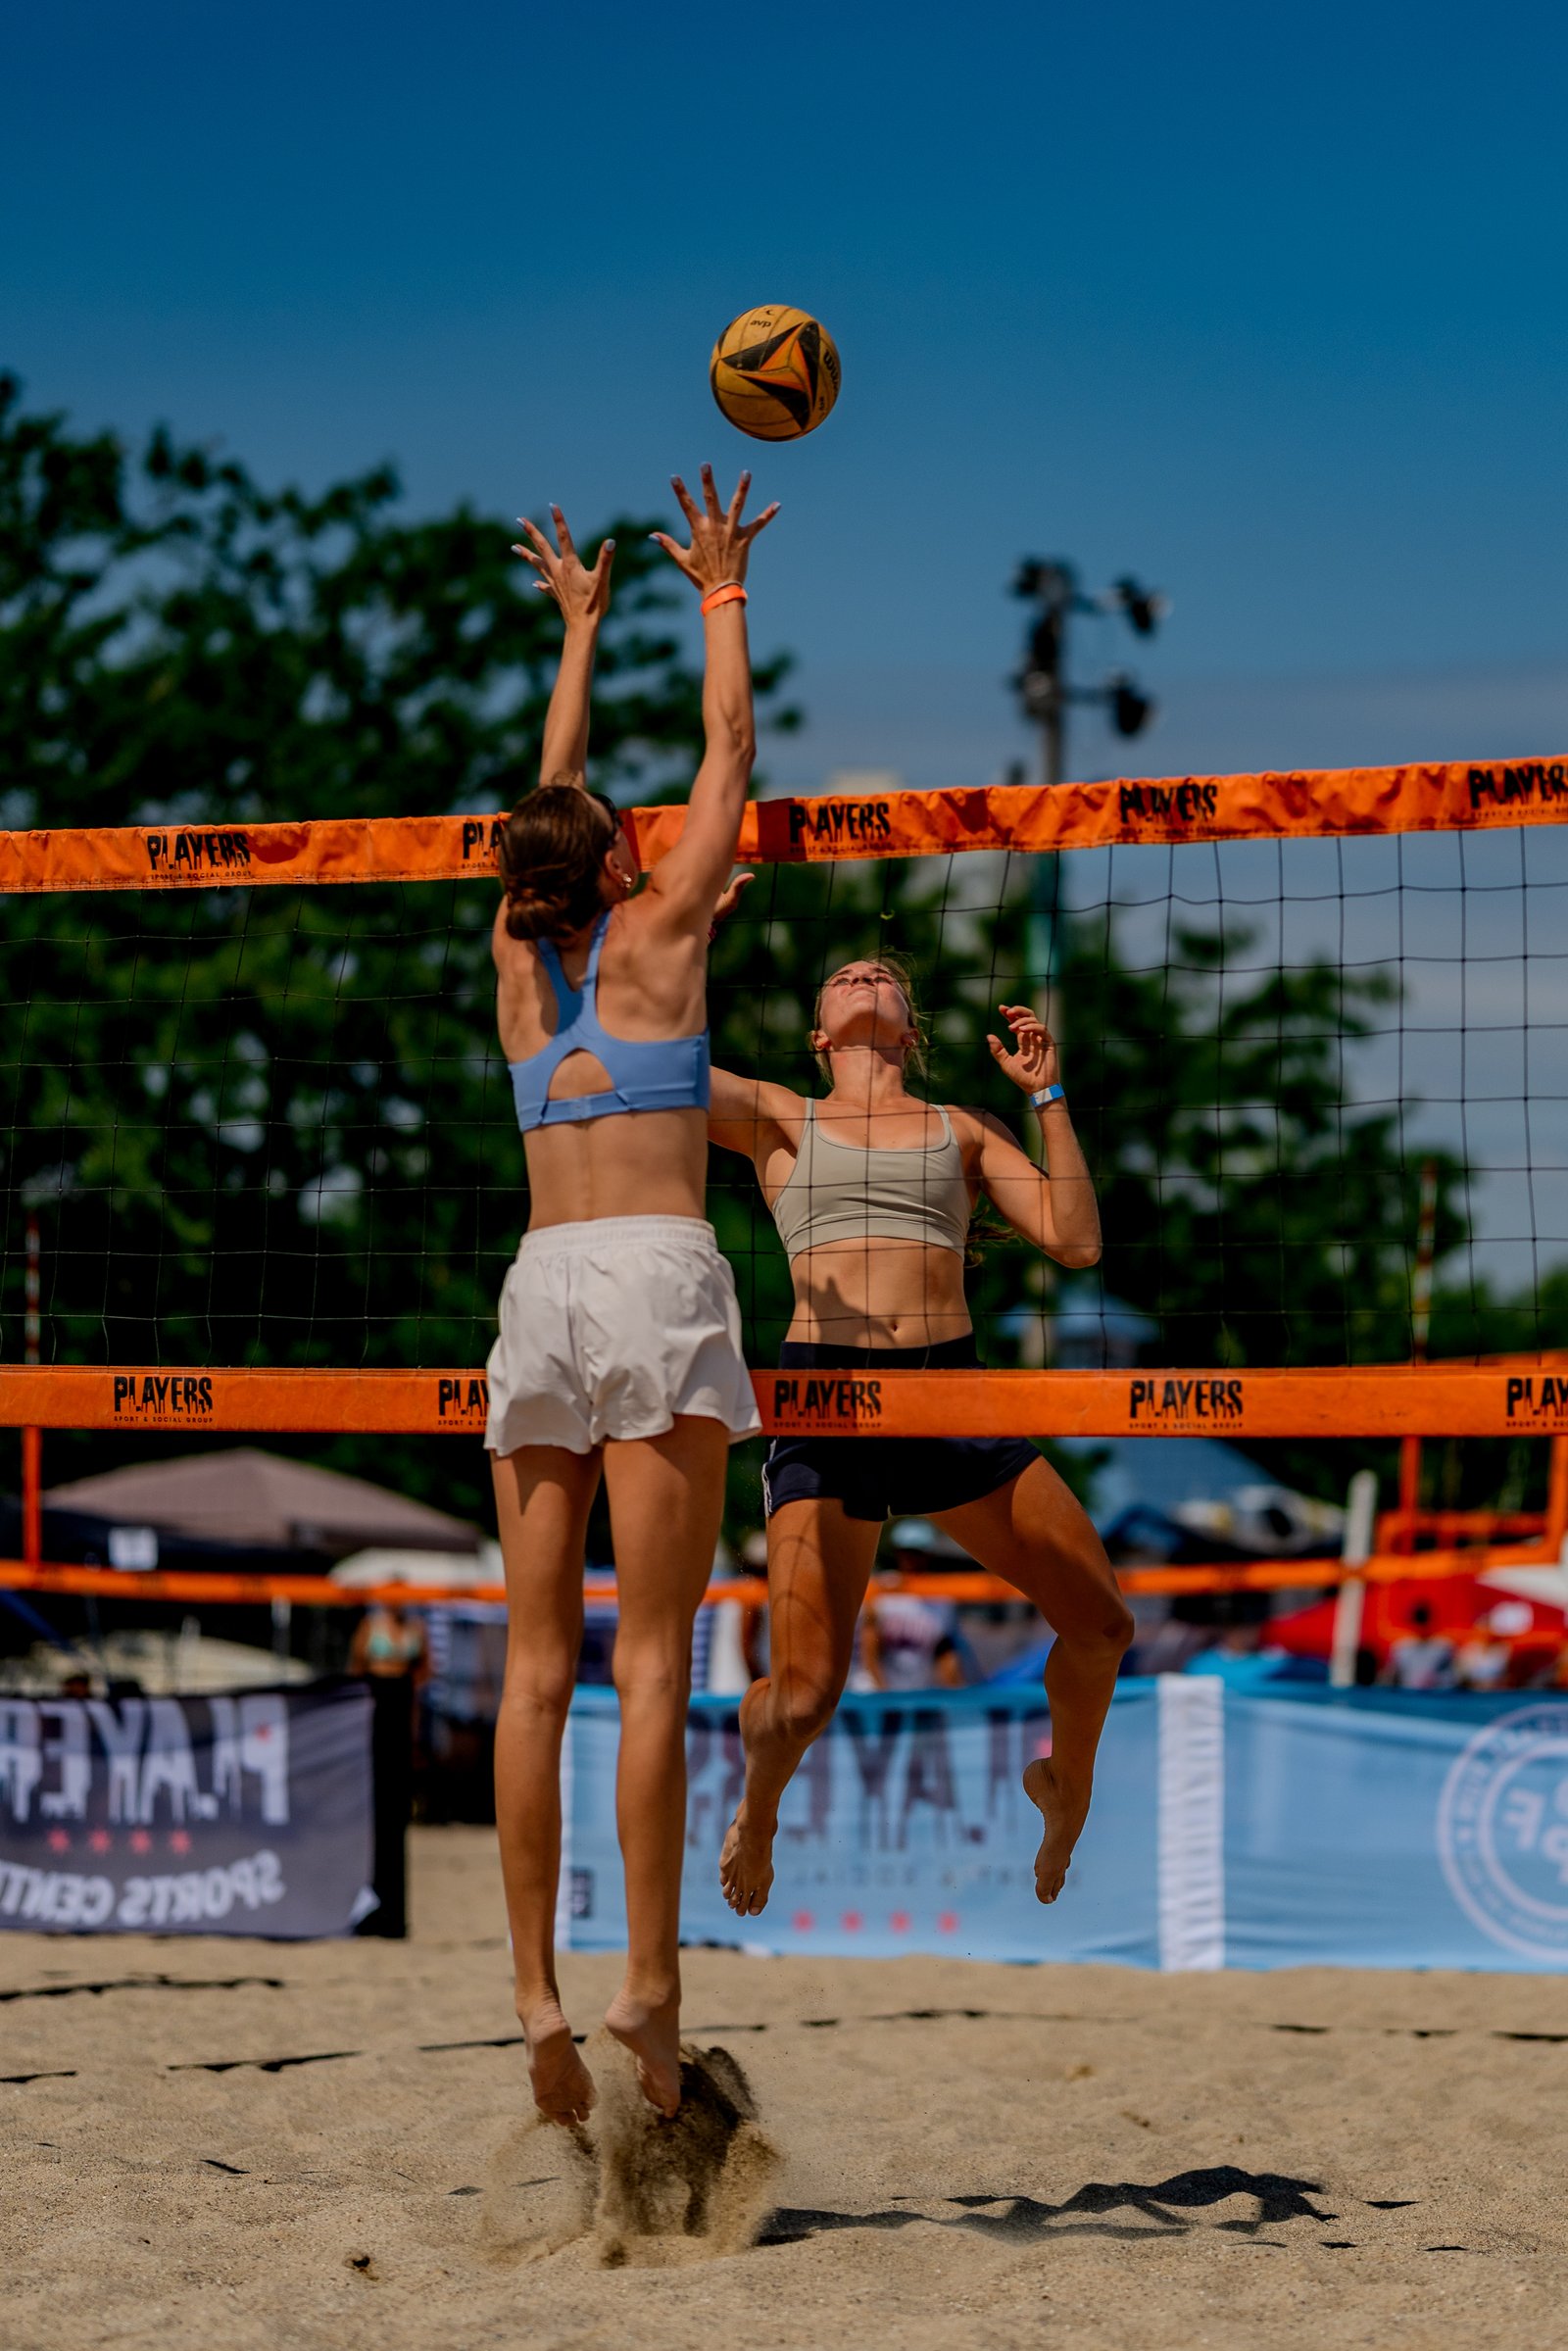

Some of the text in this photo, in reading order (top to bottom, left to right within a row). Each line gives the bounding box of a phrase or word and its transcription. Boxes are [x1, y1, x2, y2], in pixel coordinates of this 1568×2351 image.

[789, 802, 891, 845] PLAYERS
[147, 832, 251, 871] PLAYERS
[114, 1376, 213, 1414] PLAYERS
[774, 1380, 881, 1419] PLAYERS
[1130, 1380, 1243, 1419] PLAYERS
